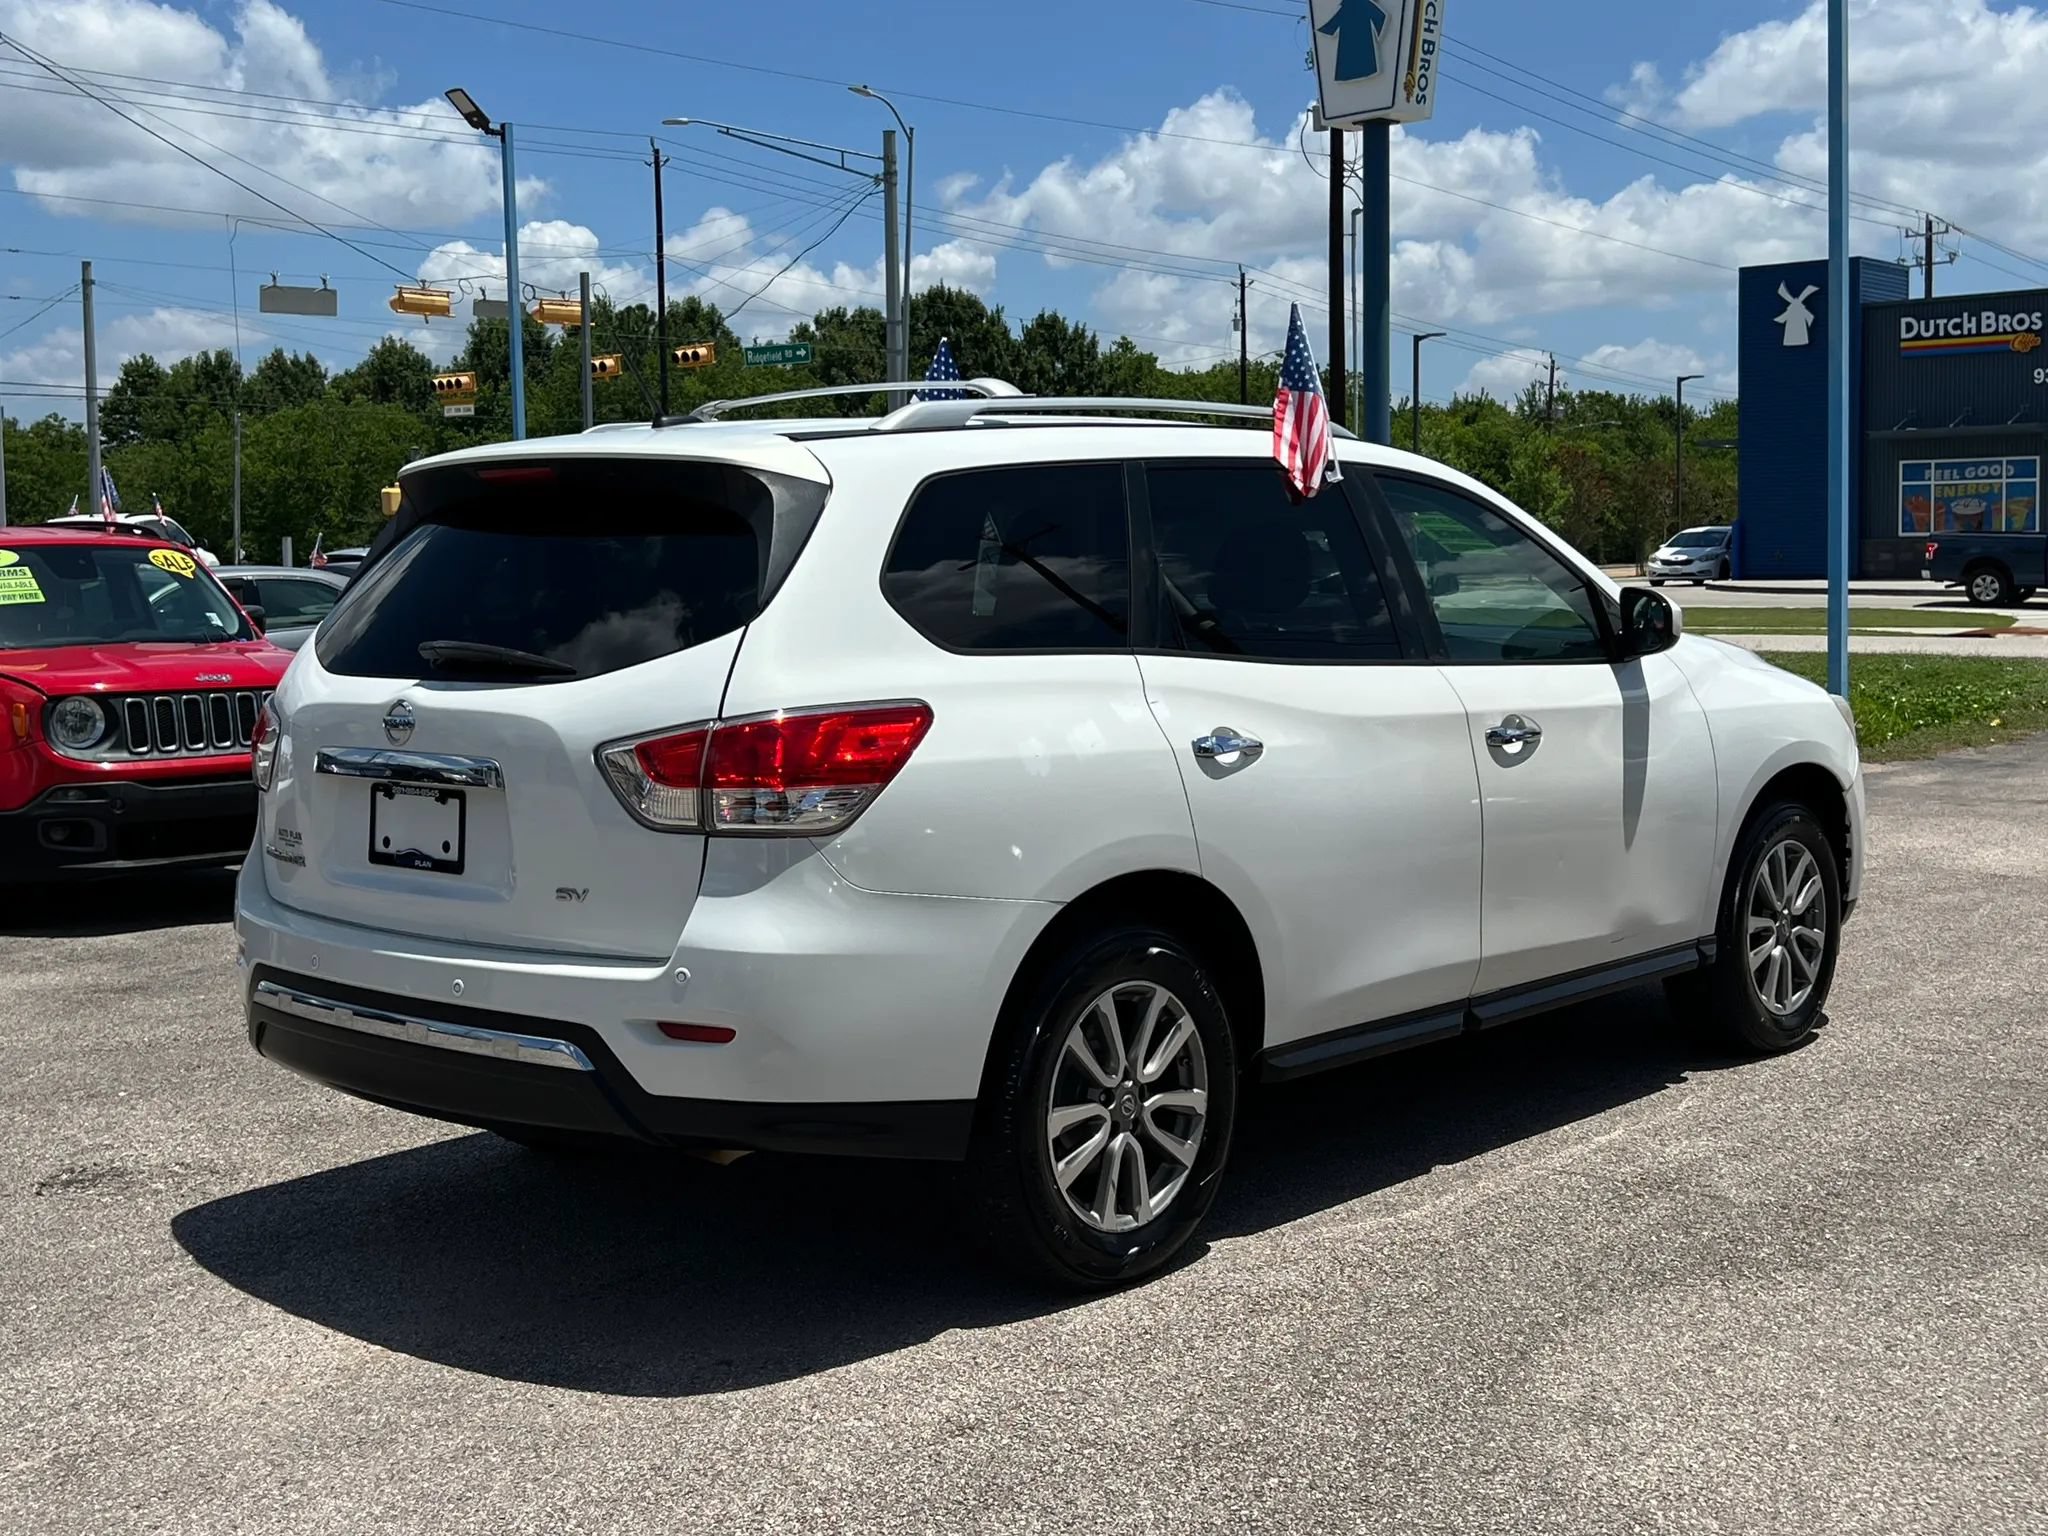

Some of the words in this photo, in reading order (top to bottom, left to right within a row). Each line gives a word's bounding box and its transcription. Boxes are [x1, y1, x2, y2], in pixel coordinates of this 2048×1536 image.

[1422, 0, 1439, 34] CH
[1415, 38, 1436, 105] BROS
[1900, 311, 1977, 339] DUTCH
[1981, 310, 2043, 333] BROS
[1924, 468, 1960, 481] FEEL
[1935, 482, 2001, 498] ENERGY
[151, 554, 193, 571] SALE
[194, 672, 231, 683] Jeep
[414, 859, 432, 869] PLAN
[555, 887, 590, 903] SV
